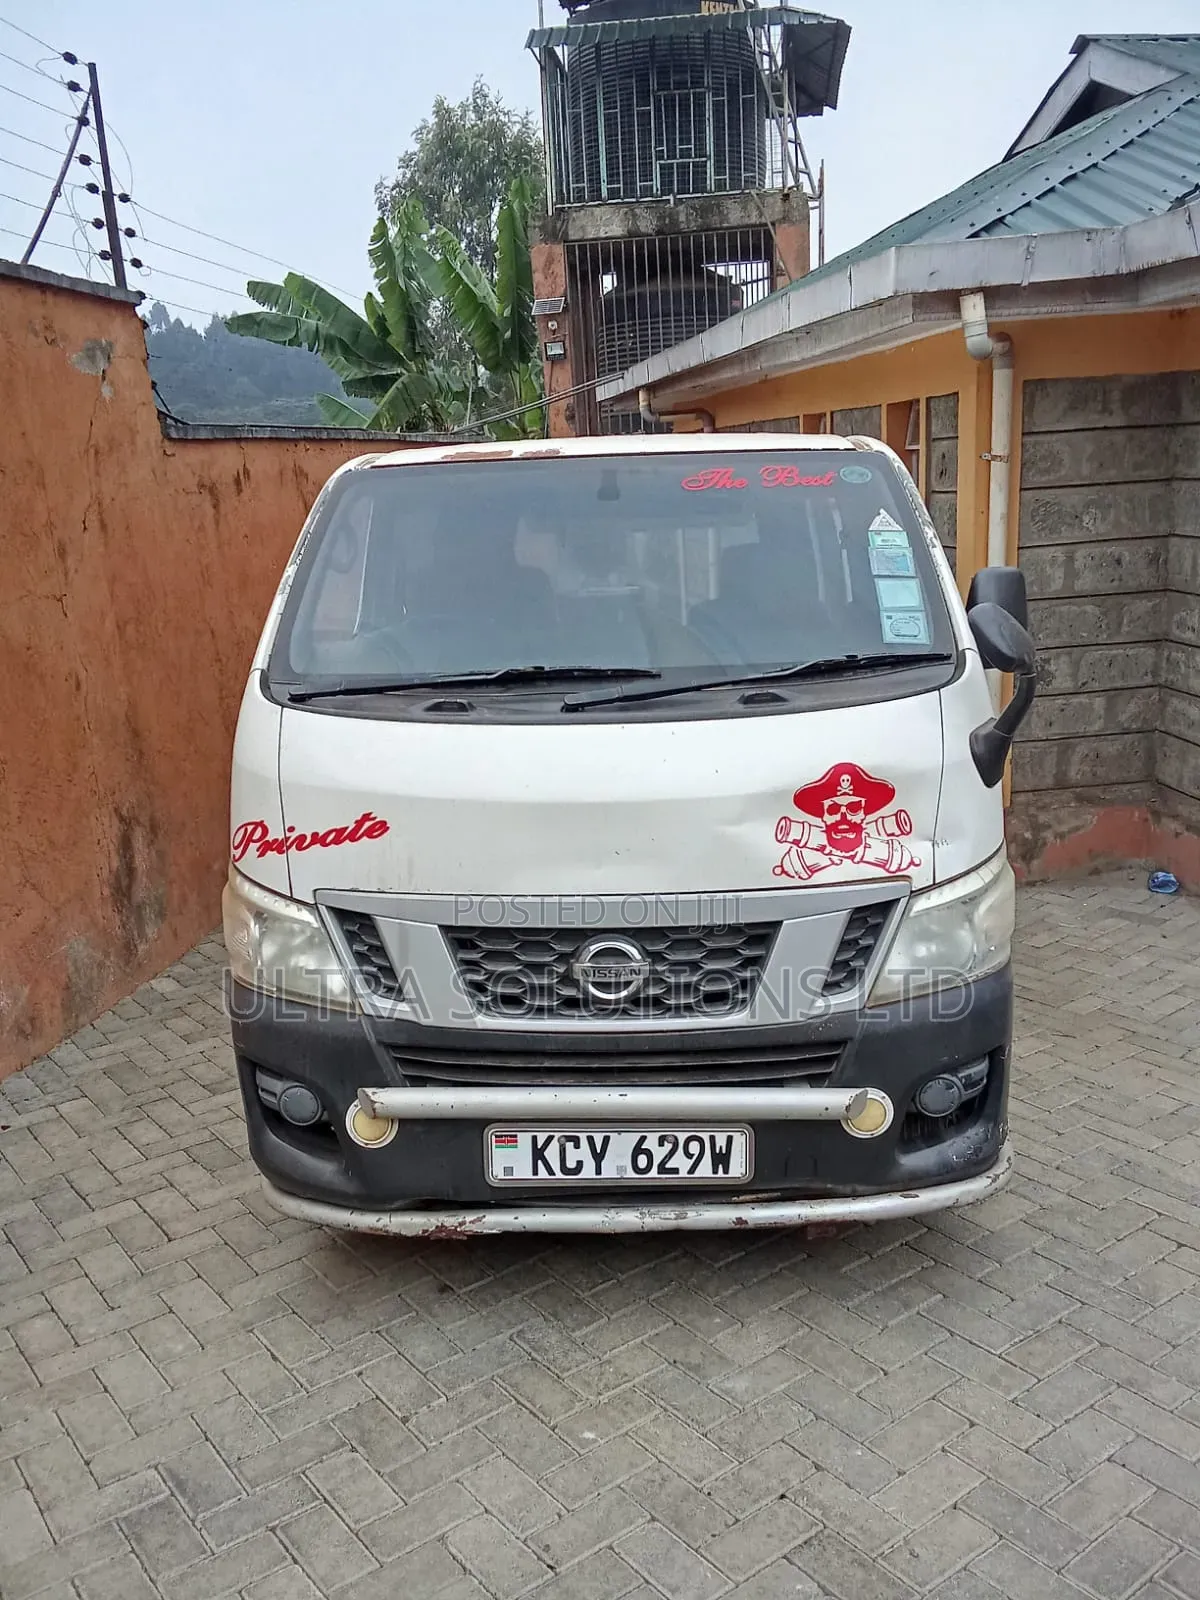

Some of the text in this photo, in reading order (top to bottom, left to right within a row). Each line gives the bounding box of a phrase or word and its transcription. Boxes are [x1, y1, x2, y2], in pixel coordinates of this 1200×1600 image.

[681, 464, 838, 491] The Best
[232, 812, 391, 862] Private
[580, 967, 641, 979] NISSAN
[531, 1134, 612, 1176] KCY
[631, 1134, 734, 1176] 629W
